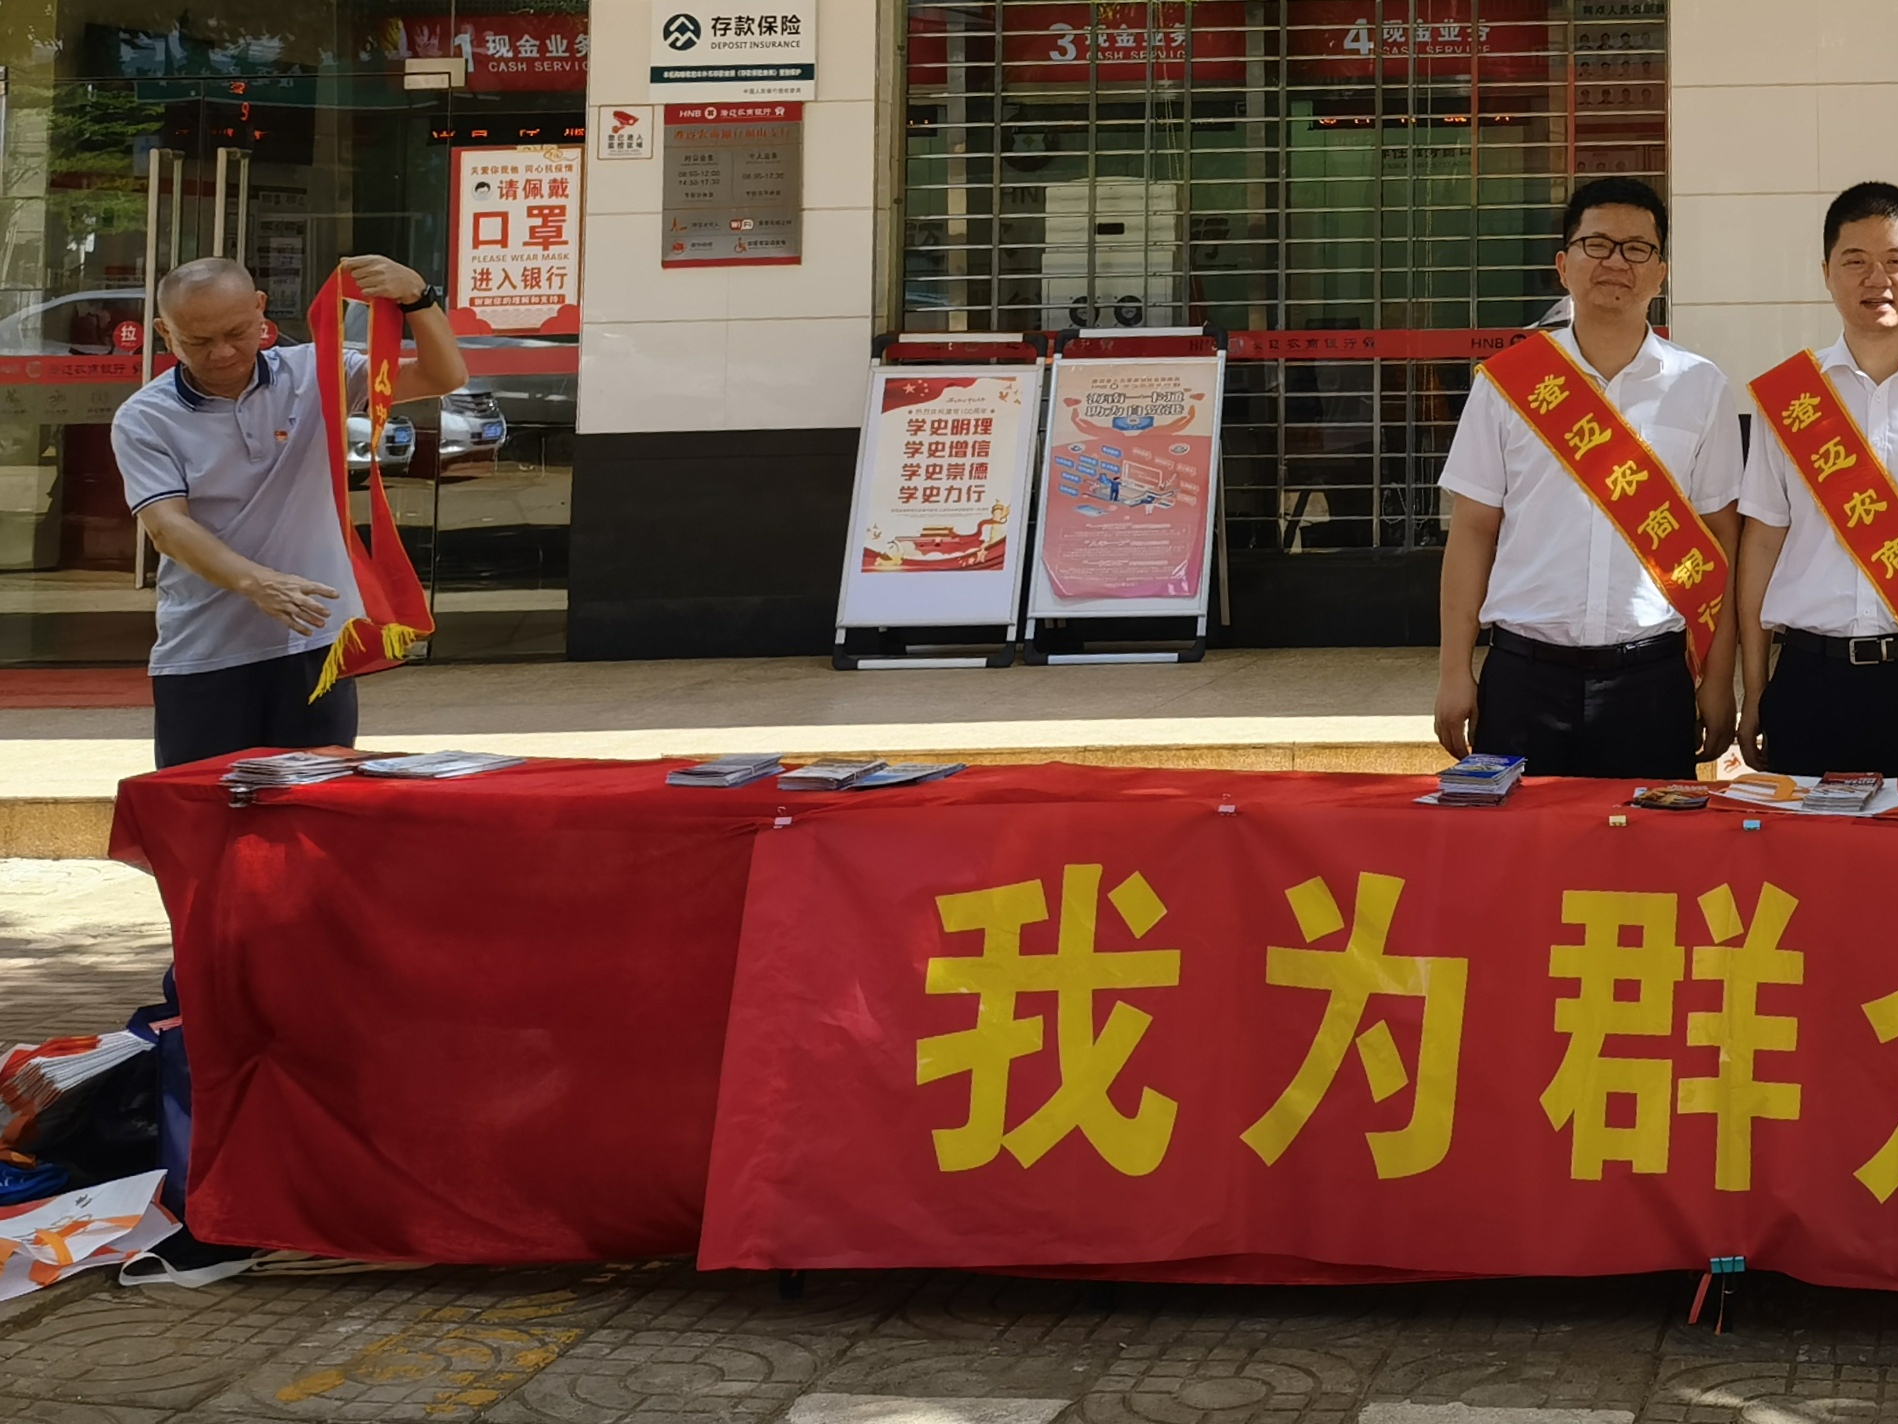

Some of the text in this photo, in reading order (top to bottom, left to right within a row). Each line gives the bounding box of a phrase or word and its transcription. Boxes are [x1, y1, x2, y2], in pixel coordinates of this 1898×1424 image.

[711, 15, 801, 37] 存款保险
[1084, 22, 1187, 48] 现金业务
[1383, 18, 1490, 42] 现金业务
[486, 34, 588, 58] 现金业务
[711, 40, 800, 49] DEPOSIT INSURANCE
[1049, 22, 1078, 61] 3
[1343, 18, 1374, 55] 4
[489, 62, 527, 72] CASH
[679, 109, 700, 117] HNB
[498, 178, 570, 201] 请佩戴
[472, 205, 570, 251] 口罩
[472, 253, 570, 263] PLEASE WEAR MASK
[471, 266, 568, 292] 进入银行
[120, 326, 137, 341] 拉
[1471, 337, 1504, 349] HNB
[906, 417, 994, 436] 学史明理
[903, 440, 991, 459] 学史增信
[901, 462, 989, 481] 学史崇德
[898, 484, 986, 504] 学史力行
